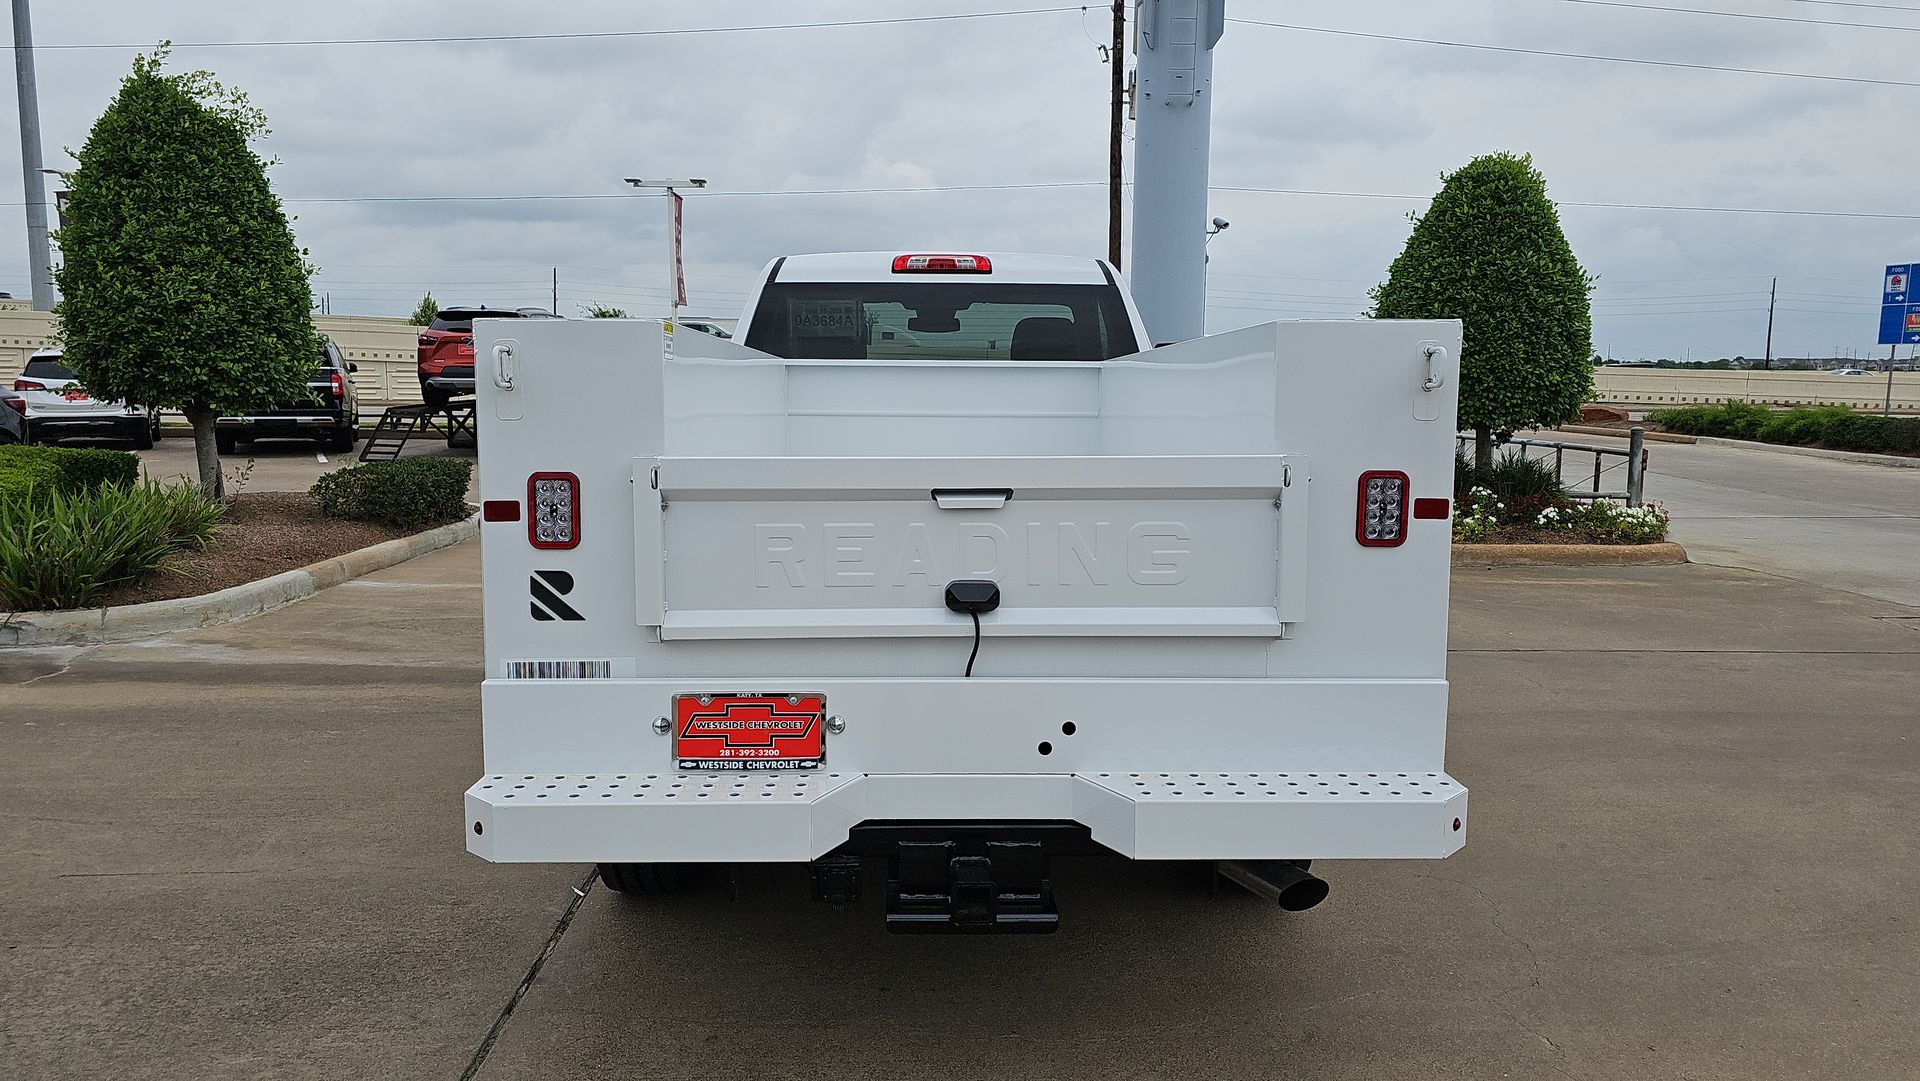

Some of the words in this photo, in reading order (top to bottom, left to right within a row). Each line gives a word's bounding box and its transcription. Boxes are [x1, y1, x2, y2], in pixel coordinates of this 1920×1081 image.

[753, 521, 1192, 588] READING
[695, 721, 744, 730] WESTSIDE
[747, 721, 804, 730] CHEVROLET
[719, 749, 780, 757] 281-392-3200
[698, 760, 744, 769] WESTSIDE
[746, 759, 800, 769] CHEVROLET
